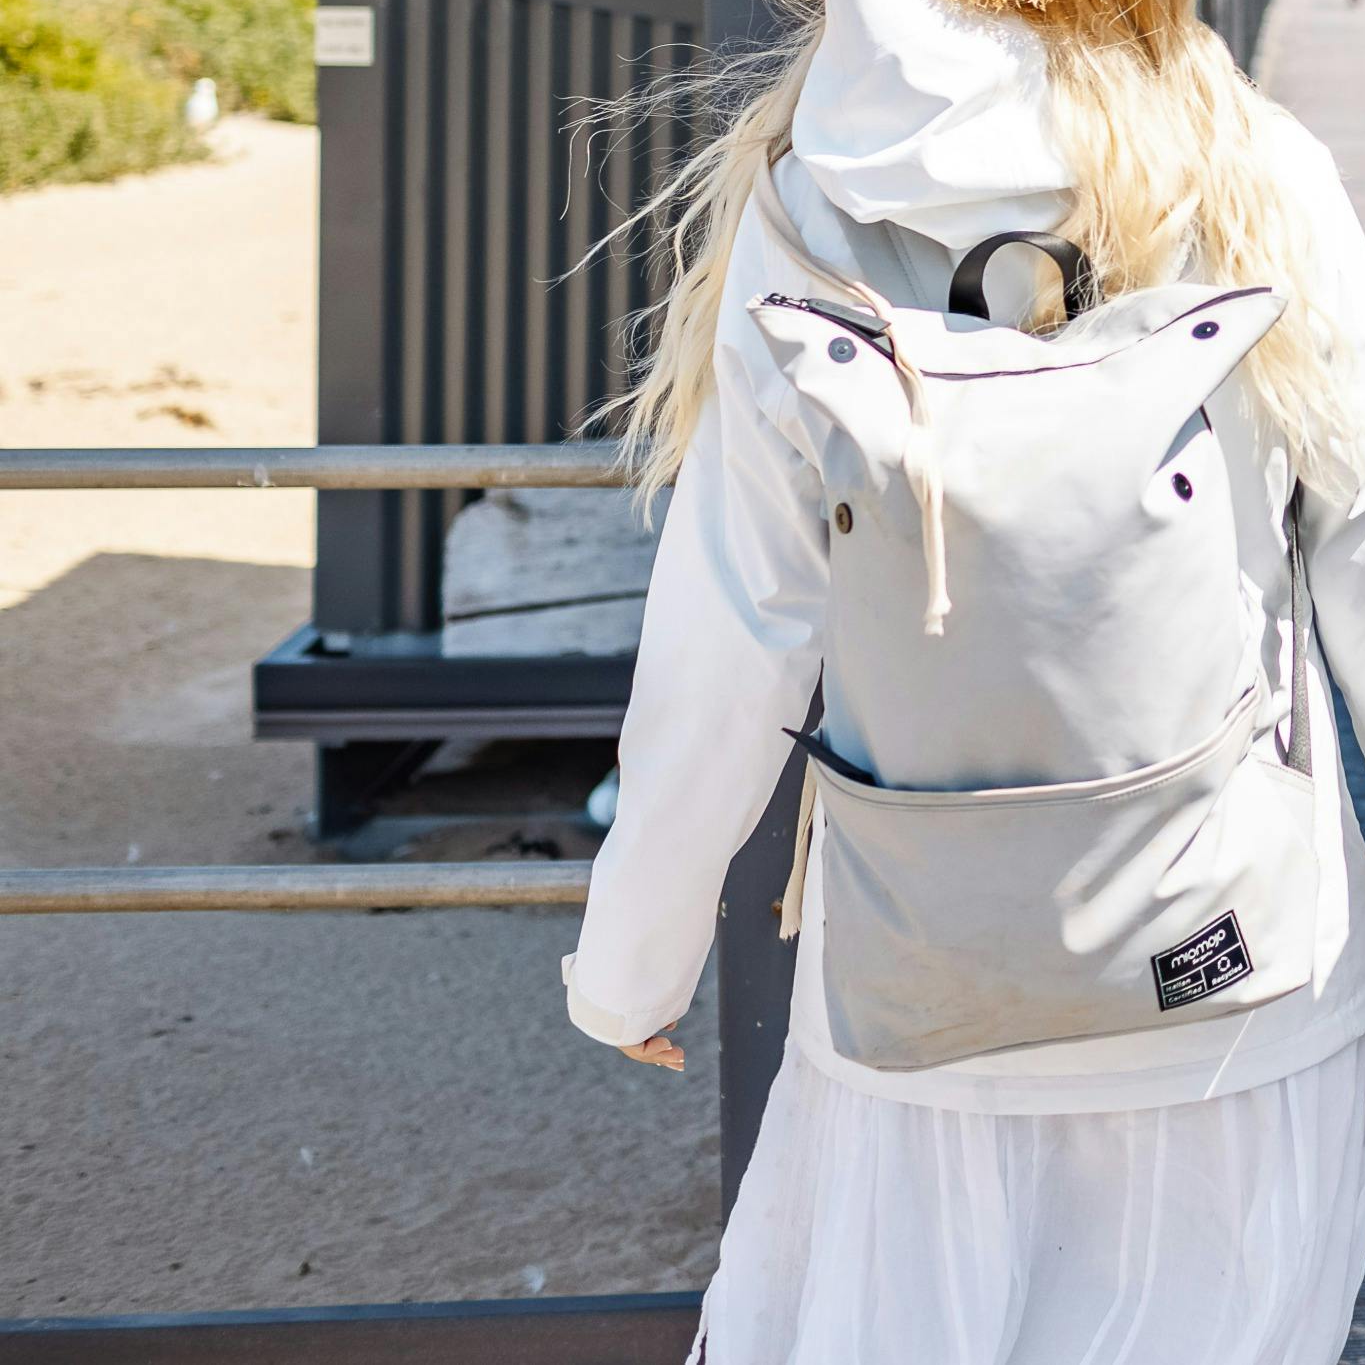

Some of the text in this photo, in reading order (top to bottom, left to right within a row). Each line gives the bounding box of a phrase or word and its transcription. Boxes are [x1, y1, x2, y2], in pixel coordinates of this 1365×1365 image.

[1171, 929, 1227, 969] miomojo
[1211, 963, 1244, 986] Recycled
[1165, 978, 1192, 993] Italian
[1168, 986, 1203, 1004] Certified
